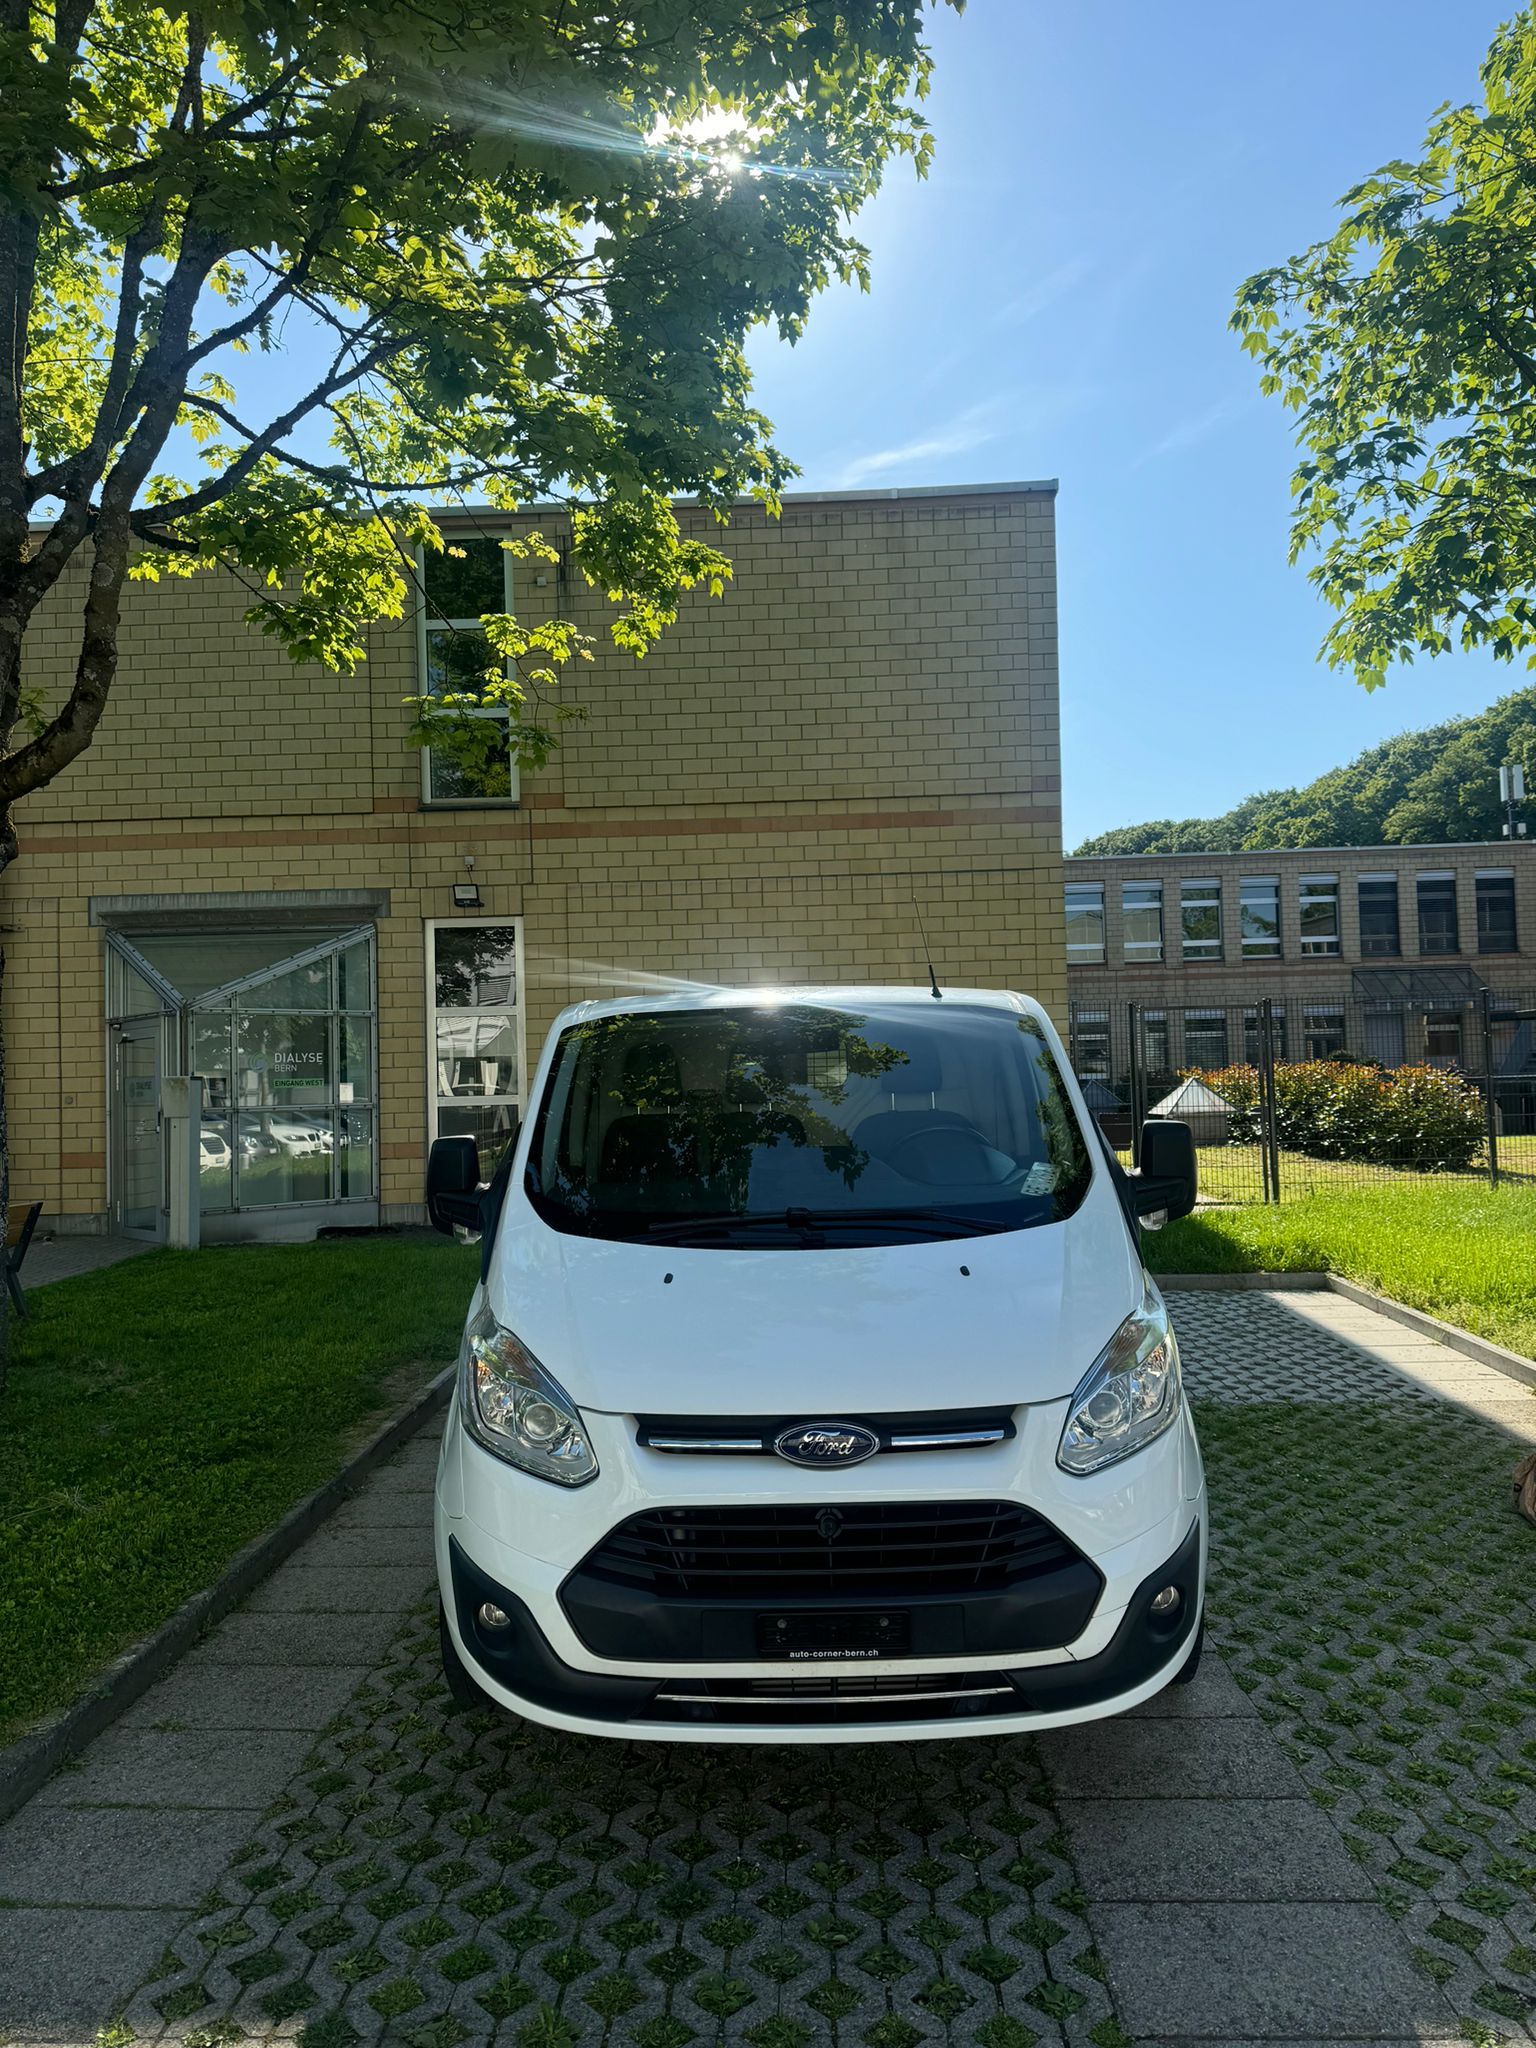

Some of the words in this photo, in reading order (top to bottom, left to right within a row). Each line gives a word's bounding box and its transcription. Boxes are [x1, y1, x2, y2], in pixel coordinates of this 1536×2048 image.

[274, 1052, 324, 1063] DIALYSE
[274, 1064, 297, 1072] BERN
[799, 1430, 855, 1455] Ford
[789, 1649, 879, 1658] auto-corner-bern.ch
